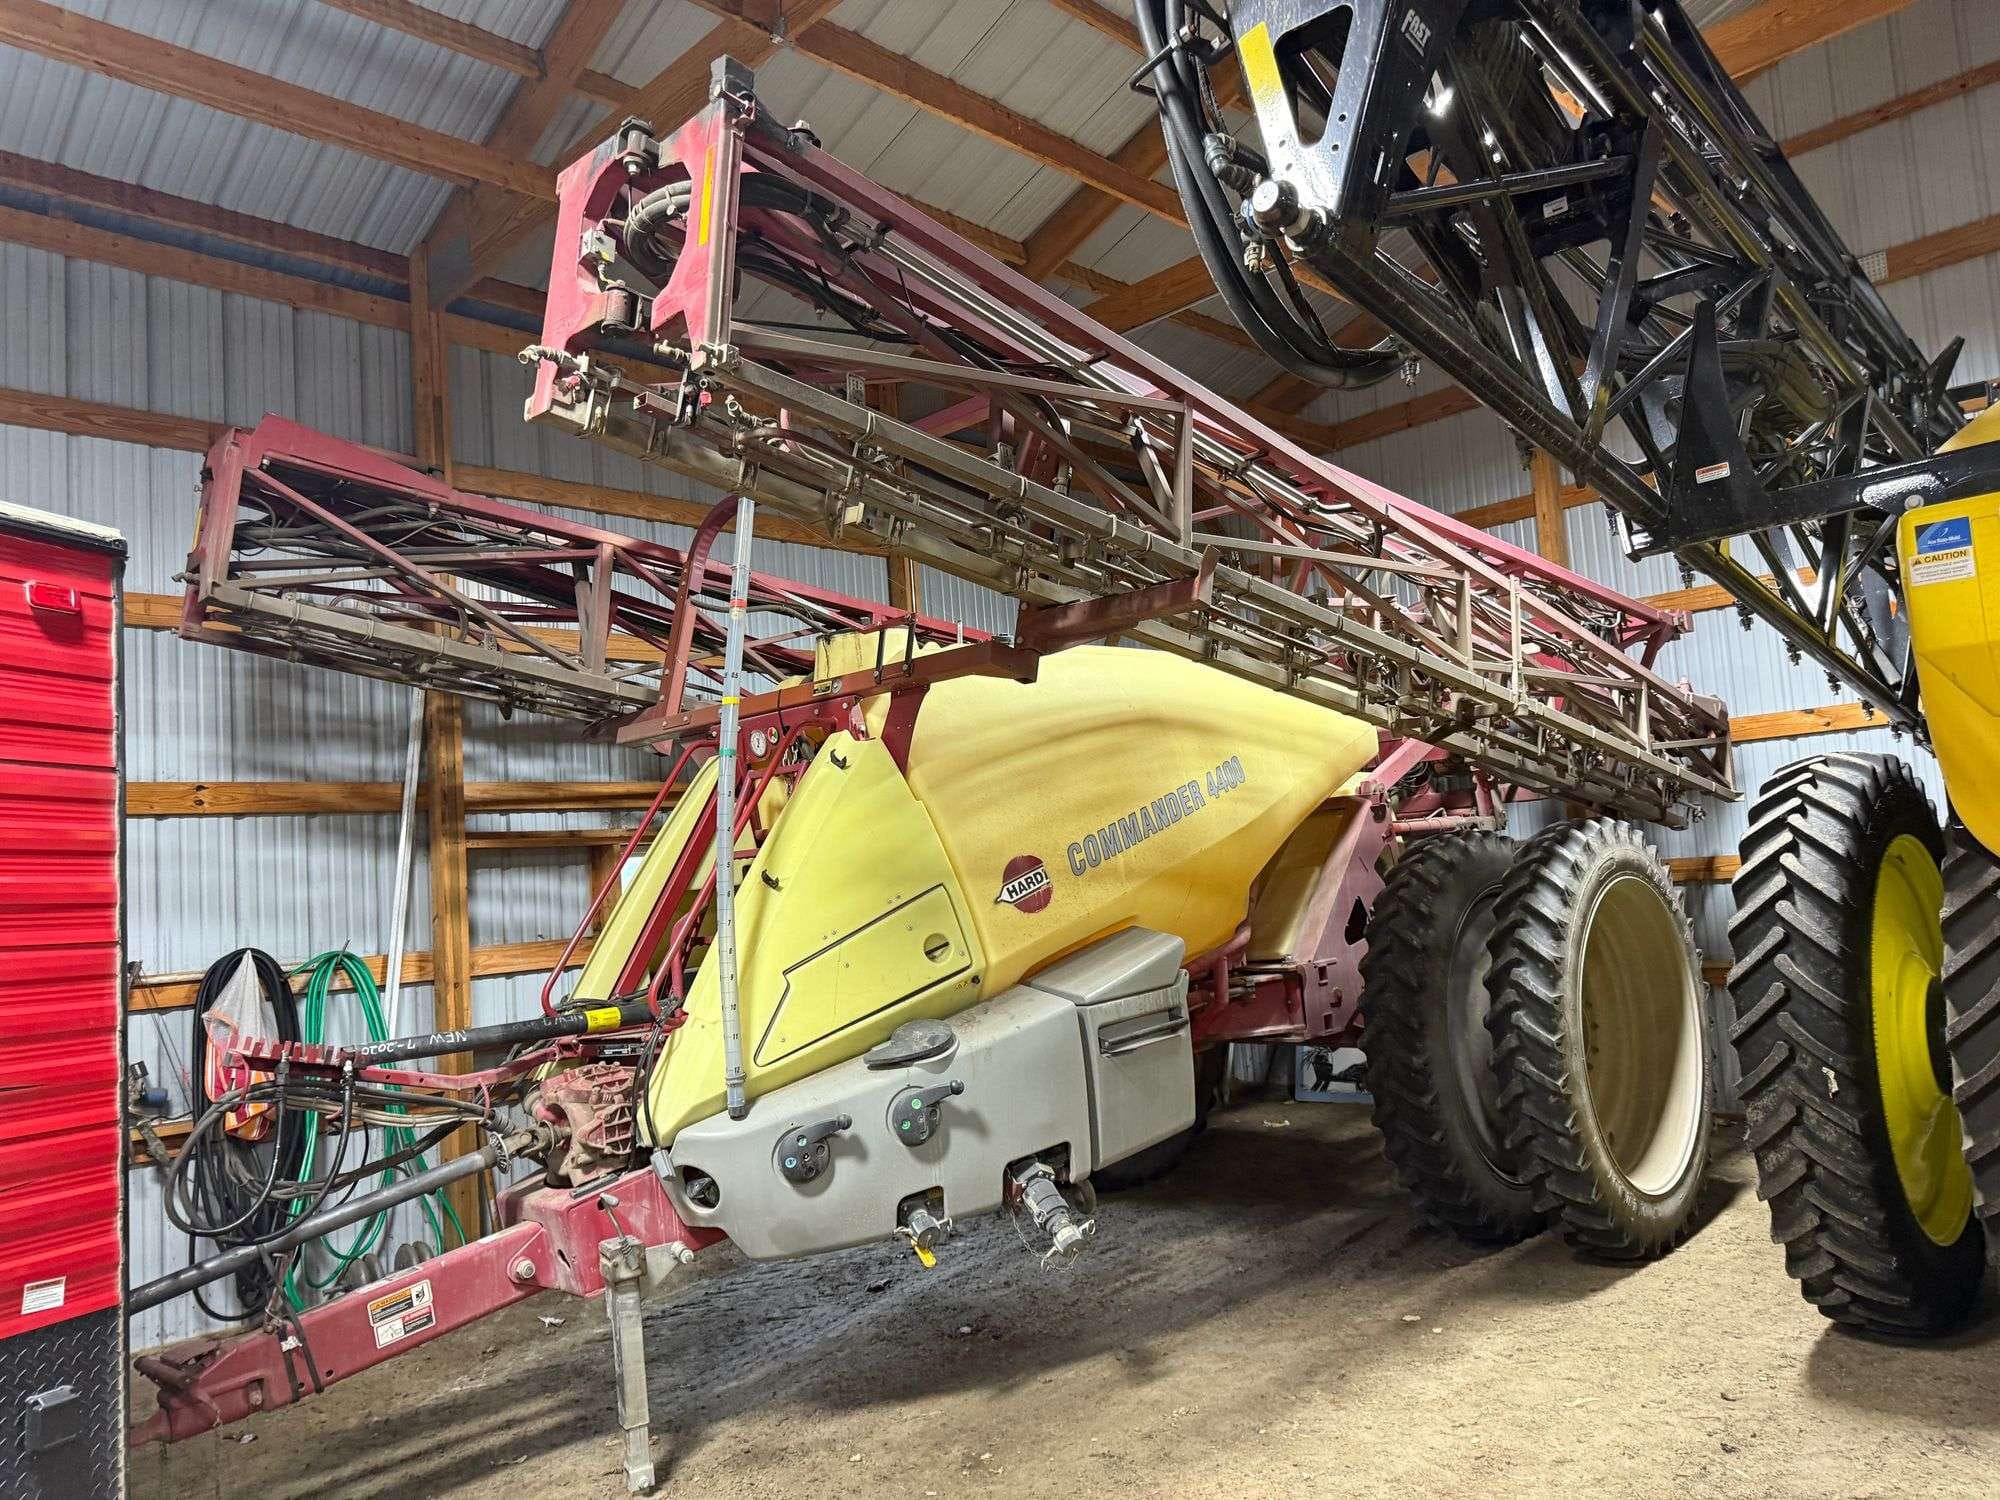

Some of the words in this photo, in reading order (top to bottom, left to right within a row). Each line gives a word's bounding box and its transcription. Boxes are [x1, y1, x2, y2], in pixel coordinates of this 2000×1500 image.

[1401, 9, 1431, 44] FAST
[1924, 549, 1967, 563] CAUTION
[1066, 779, 1206, 877] COMMANDER
[1206, 755, 1246, 799] 4400
[429, 1031, 468, 1044] NEW
[361, 1039, 416, 1055] 7-2020
